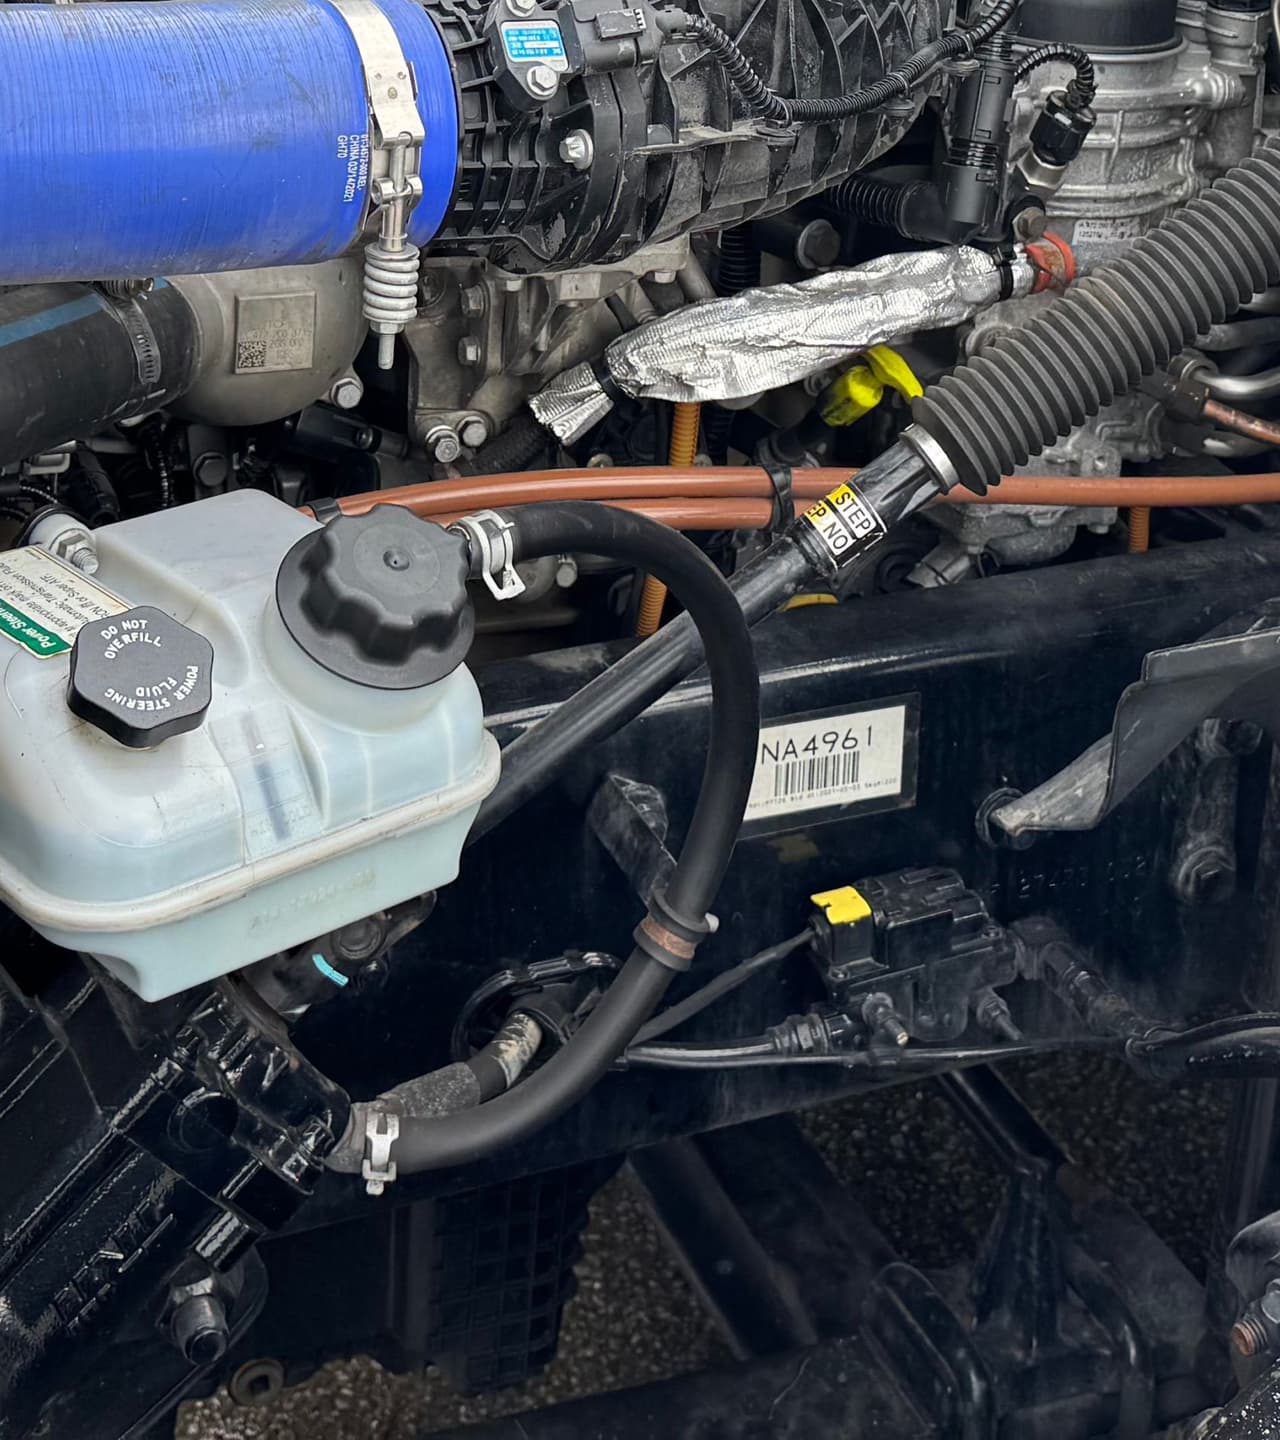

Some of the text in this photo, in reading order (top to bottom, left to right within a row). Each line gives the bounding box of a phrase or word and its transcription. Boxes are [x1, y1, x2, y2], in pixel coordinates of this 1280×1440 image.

[336, 134, 347, 158] GH70
[342, 134, 359, 202] CHINA 03/14/2021
[835, 491, 872, 531] STEP
[822, 522, 848, 551] NO
[22, 622, 56, 649] Power
[100, 619, 148, 640] DO NOT
[104, 632, 162, 659] OVERFILL
[104, 665, 199, 711] POWER STEERING
[135, 676, 178, 697] FLUID
[761, 724, 873, 765] NA4961
